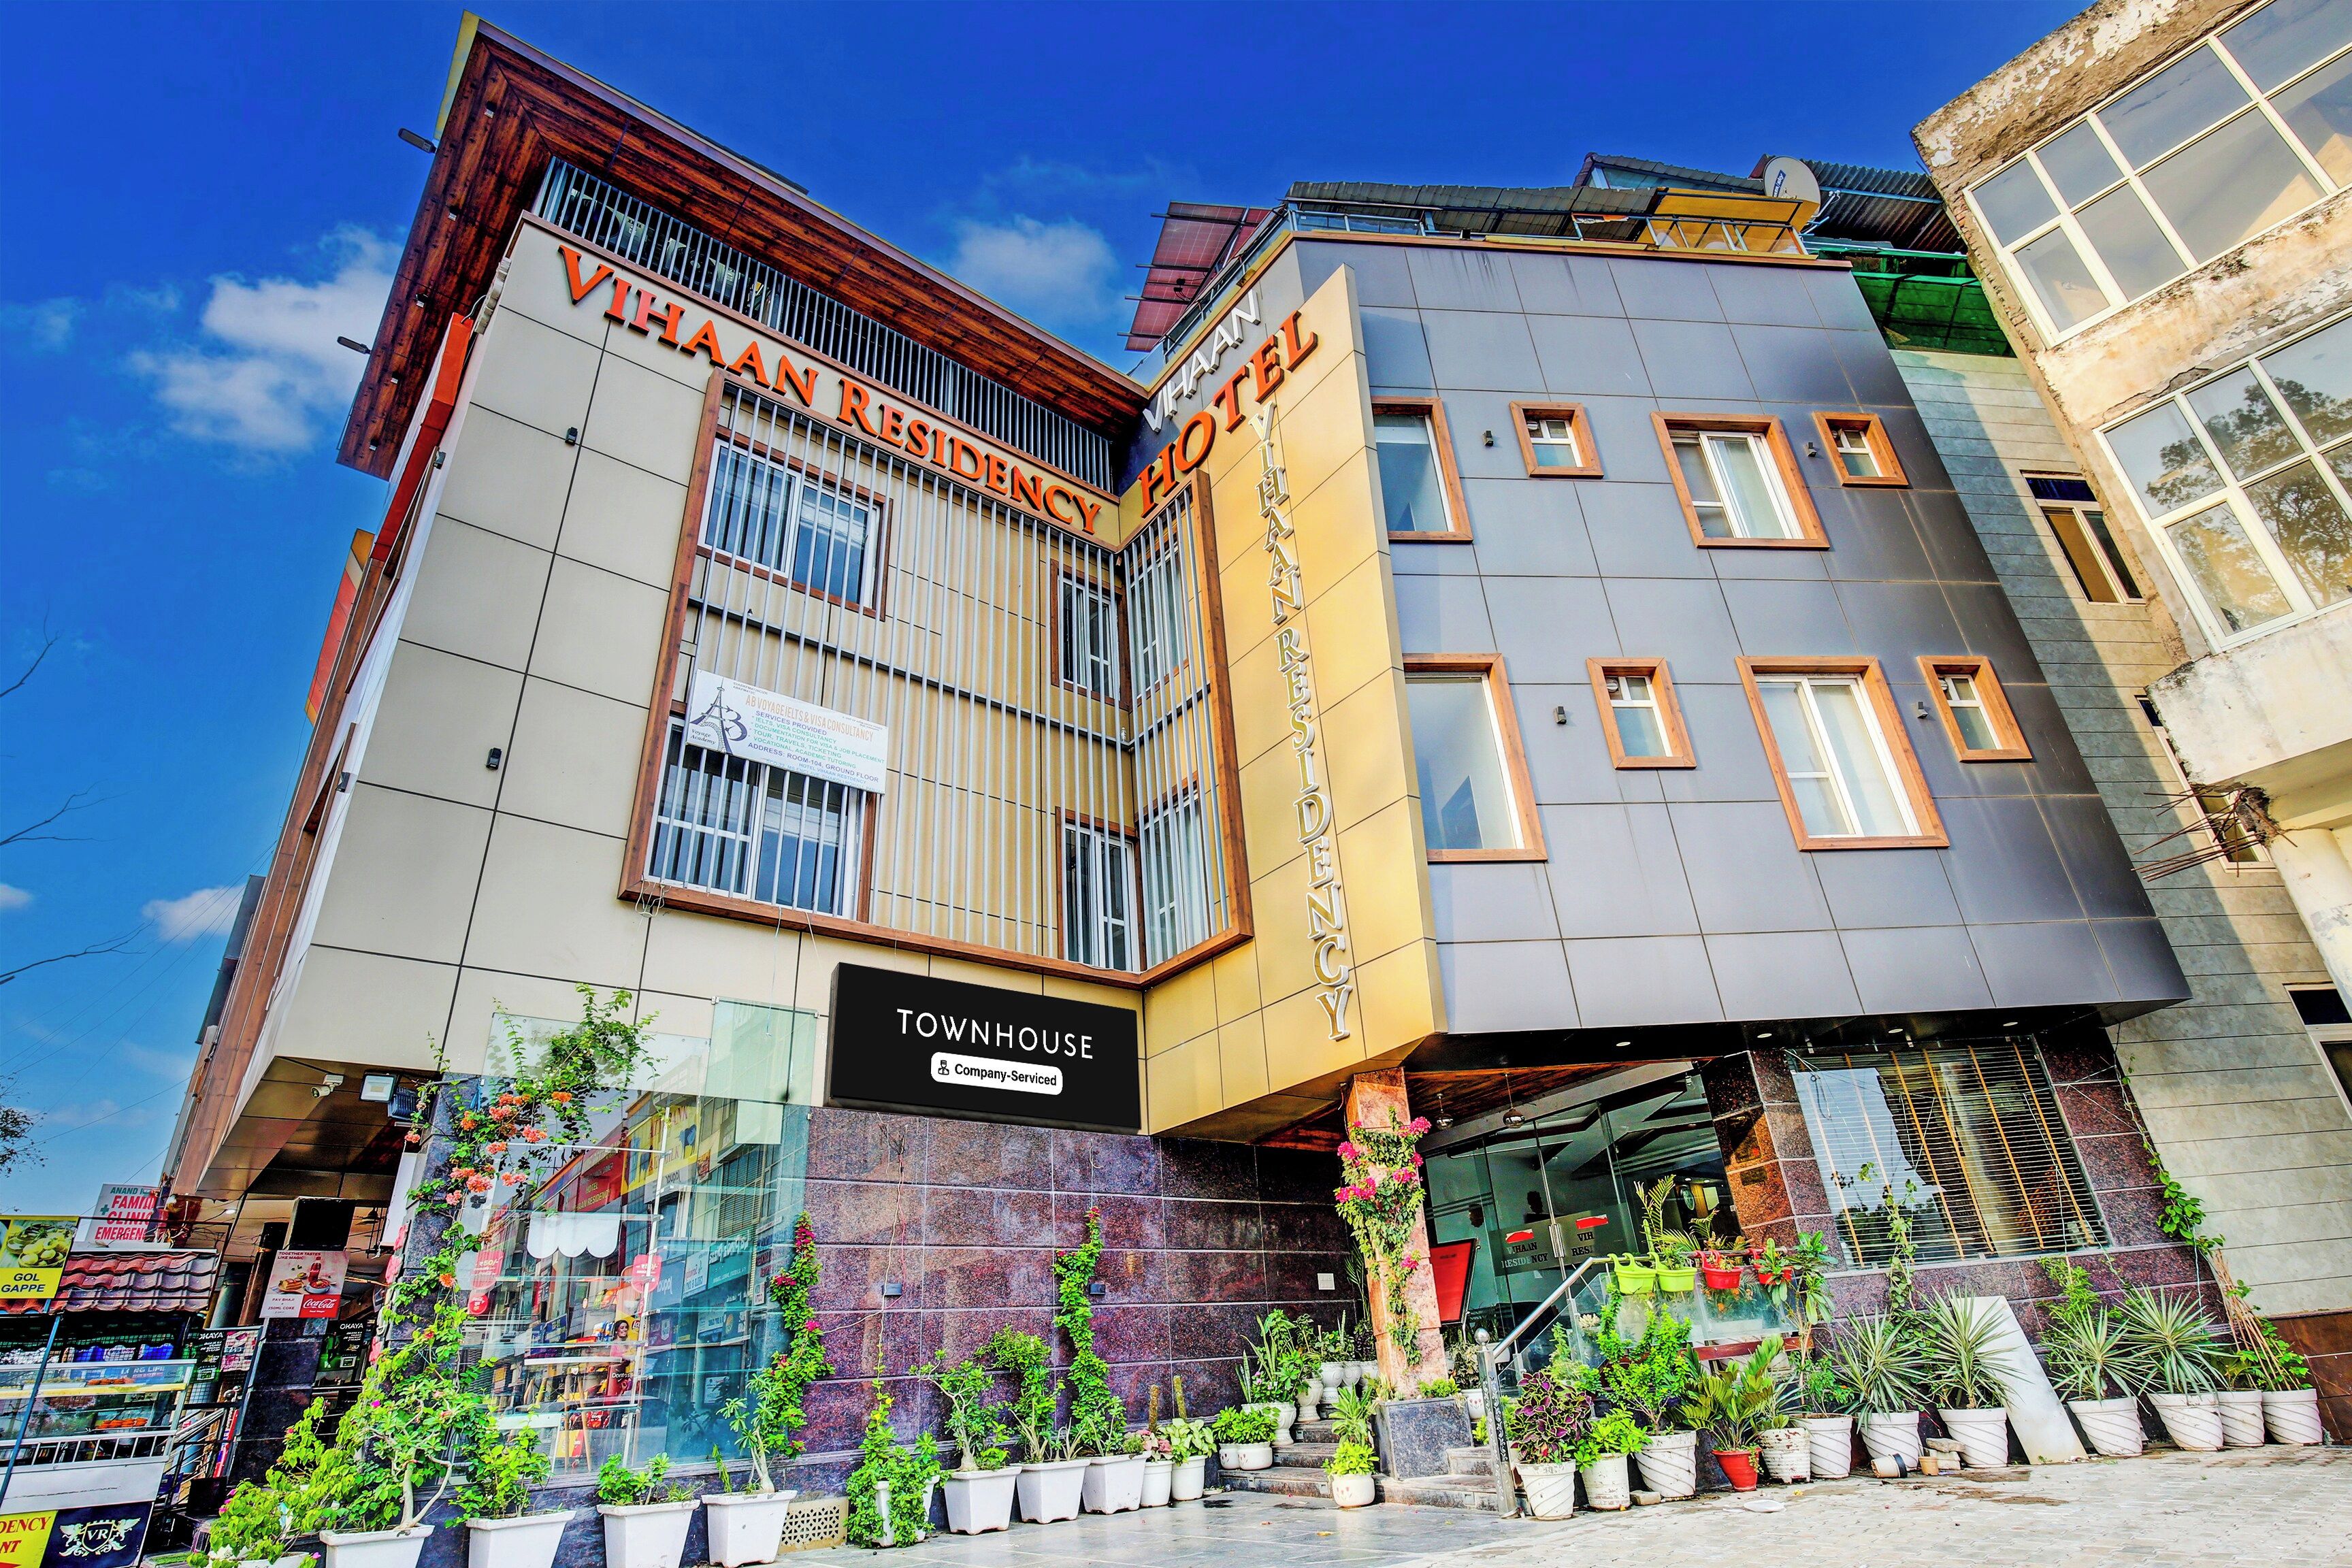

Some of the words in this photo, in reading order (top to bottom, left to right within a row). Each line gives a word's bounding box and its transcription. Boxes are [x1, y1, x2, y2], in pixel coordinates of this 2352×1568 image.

[1142, 288, 1262, 434] VIHAAN
[557, 244, 819, 407] VIHAAN
[836, 377, 1102, 536] RESIDENCY
[1137, 310, 1319, 519] HOTEL
[1248, 400, 1303, 625] VIHAAN
[746, 695, 756, 706] AB
[757, 698, 785, 716] VOYAGE
[785, 706, 803, 721] IELTS
[811, 713, 826, 728] VISA
[827, 719, 873, 742] CONSULTANCY
[755, 710, 790, 725] SERVICES
[791, 721, 827, 736] PROVIDED
[690, 735, 716, 745] Academy
[691, 729, 711, 738] Voyage
[755, 723, 805, 741] DOCUMENTATION
[820, 741, 833, 749] VISA
[851, 751, 885, 764] PLACEMENT
[792, 726, 836, 744] CONSULTANCY
[795, 748, 826, 760] ACADEMIC
[828, 757, 856, 769] TUTORING
[808, 745, 842, 758] TICKETING
[799, 763, 815, 771] HOTEL
[826, 763, 855, 776] GROUND
[856, 772, 879, 783] FLOOR
[1274, 626, 1354, 1041] RESIDENCY
[896, 1008, 1093, 1060] TOWNHOUSE
[954, 1063, 1057, 1087] Company-Serviced
[95, 1227, 148, 1240] EMERGEN
[1506, 1242, 1537, 1254] VIHAAN
[1501, 1253, 1548, 1269] RESIDENCY
[1, 1284, 46, 1292] GAPPE
[87, 1529, 108, 1541] VR
